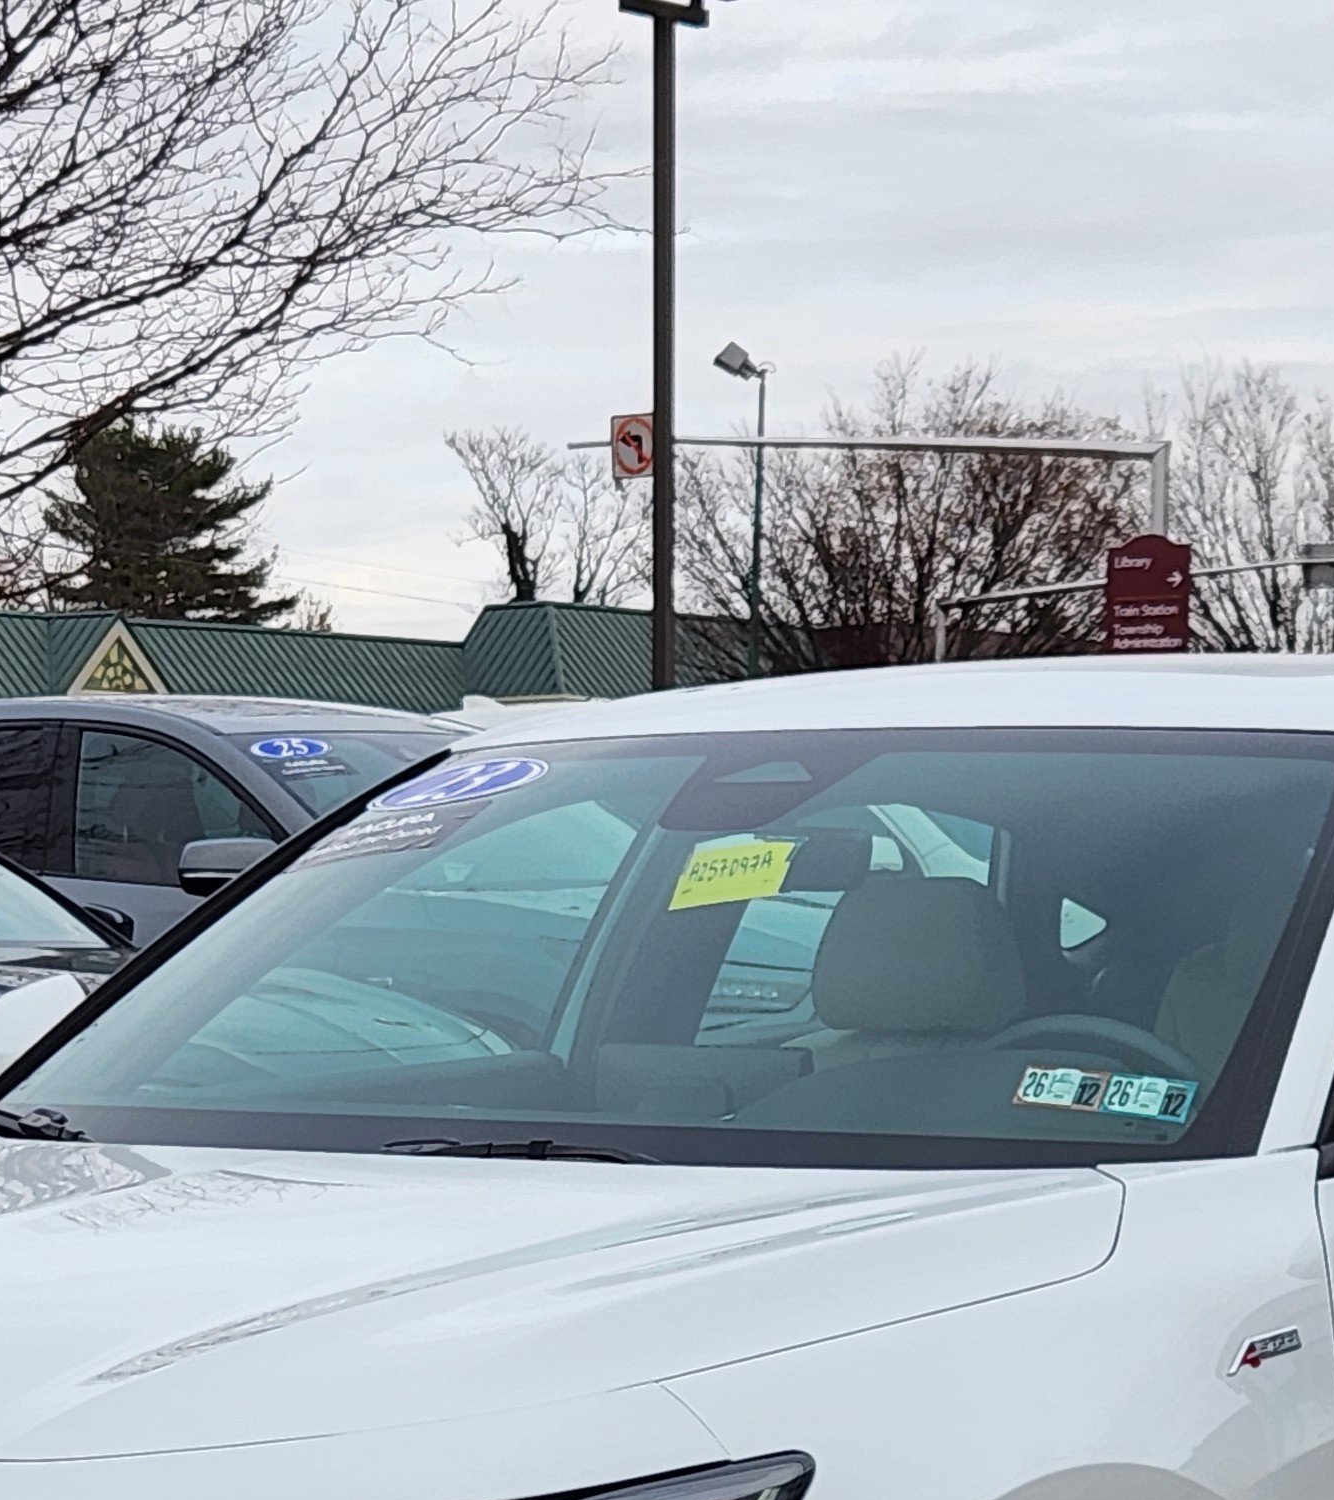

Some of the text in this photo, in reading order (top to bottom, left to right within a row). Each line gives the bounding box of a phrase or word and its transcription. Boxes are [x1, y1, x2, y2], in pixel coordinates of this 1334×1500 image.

[1113, 556, 1153, 570] Library
[1113, 604, 1179, 618] Train Station
[273, 738, 309, 756] 25
[1023, 1072, 1101, 1107] 26 12
[1108, 1080, 1187, 1118] 26 12
